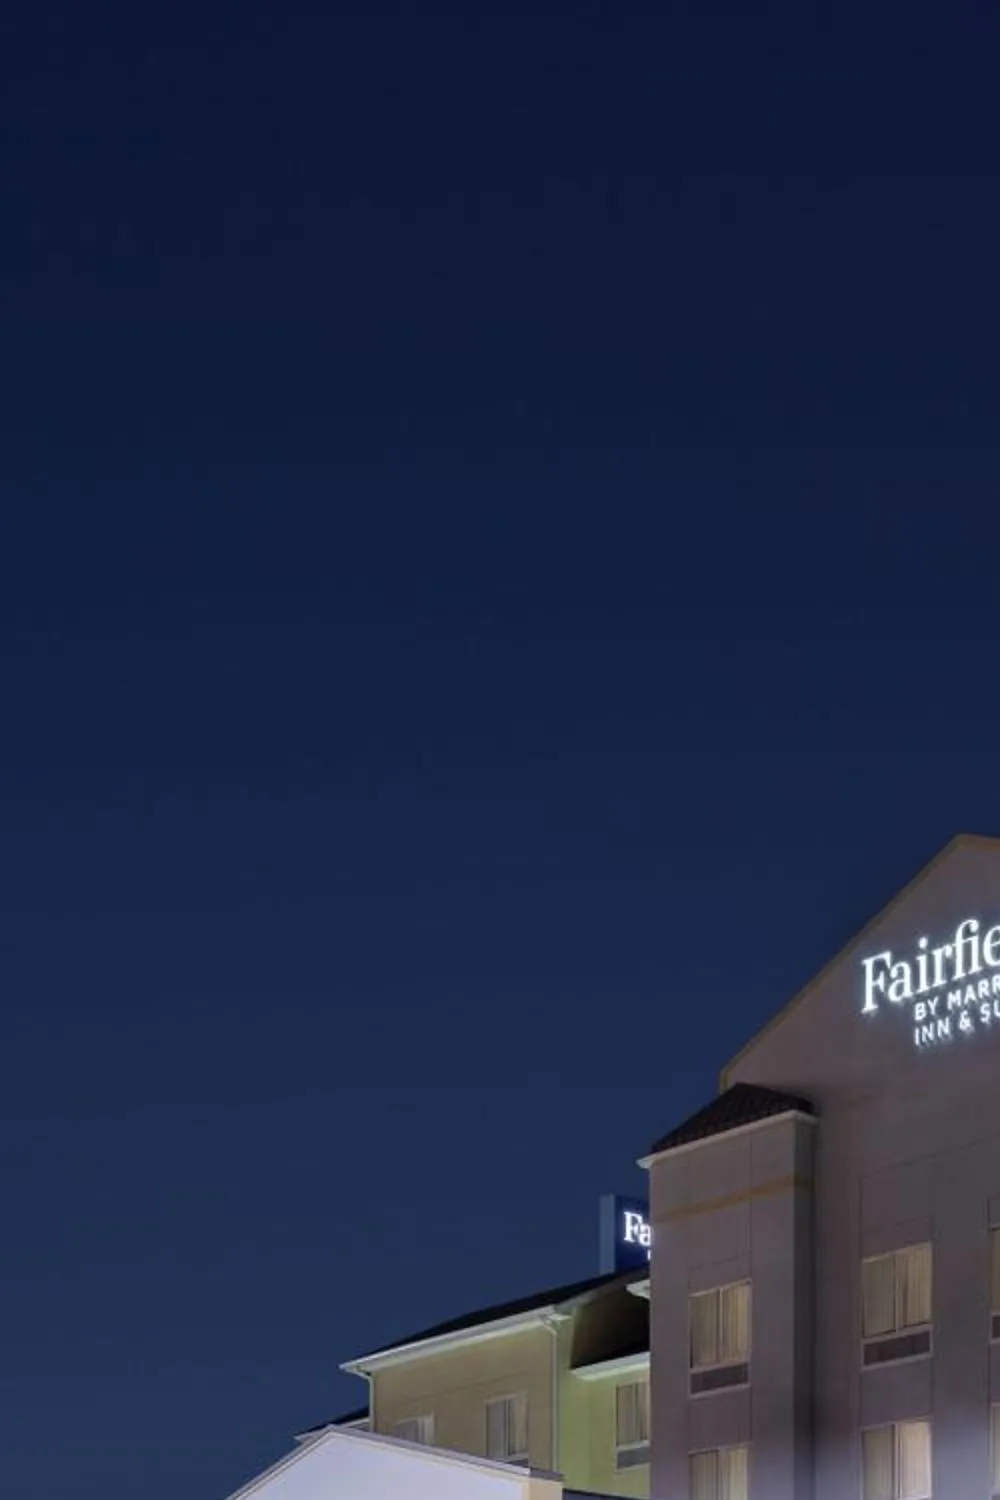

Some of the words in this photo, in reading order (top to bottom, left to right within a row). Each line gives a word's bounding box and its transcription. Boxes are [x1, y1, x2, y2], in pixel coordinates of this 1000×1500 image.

[914, 997, 939, 1021] BY
[914, 1017, 950, 1046] INN
[959, 1012, 973, 1031] &
